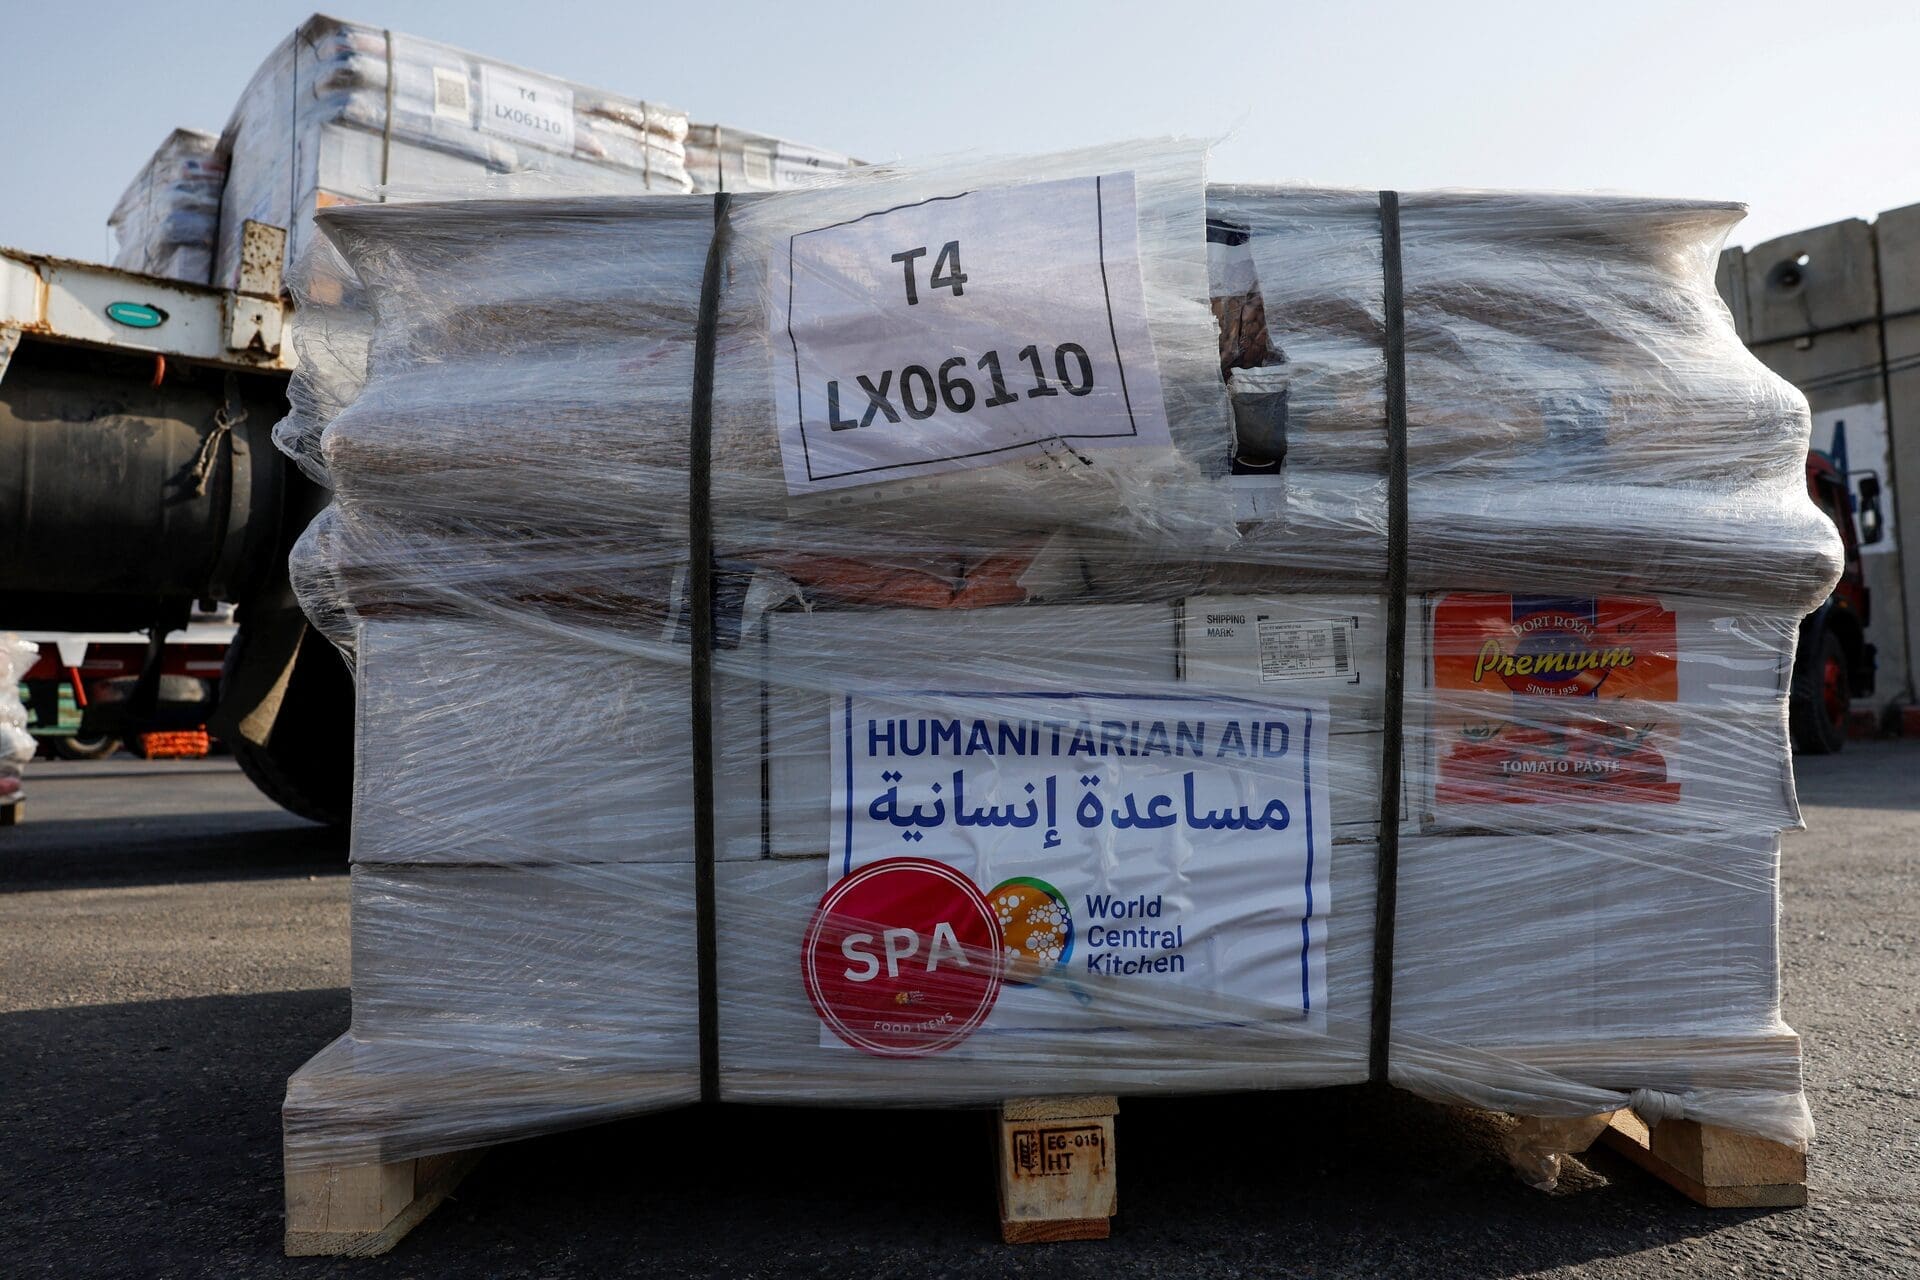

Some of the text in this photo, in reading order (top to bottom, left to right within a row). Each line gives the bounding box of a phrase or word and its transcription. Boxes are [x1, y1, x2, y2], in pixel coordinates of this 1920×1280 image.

[519, 87, 536, 102] T4
[496, 105, 561, 133] LX06110
[891, 240, 968, 305] T4
[826, 342, 1094, 431] LX06110
[1206, 614, 1246, 625] SHIPPING
[1511, 615, 1595, 641] PORT ROYAL
[1207, 628, 1234, 638] MARK:
[1473, 639, 1635, 683] Premium
[1526, 683, 1556, 696] SINCE
[868, 719, 1290, 758] HUMANITARIAN AID
[1500, 760, 1621, 773] TOMATO PASTE
[868, 769, 1290, 849] مساعدة إنسانية
[1085, 894, 1162, 919] World
[1087, 925, 1182, 948] Central
[841, 921, 970, 982] SPA
[1087, 953, 1185, 976] Kitchen
[874, 1012, 953, 1033] FOOD ITEMS
[1048, 1134, 1099, 1149] EG-015
[1048, 1153, 1073, 1170] HT
